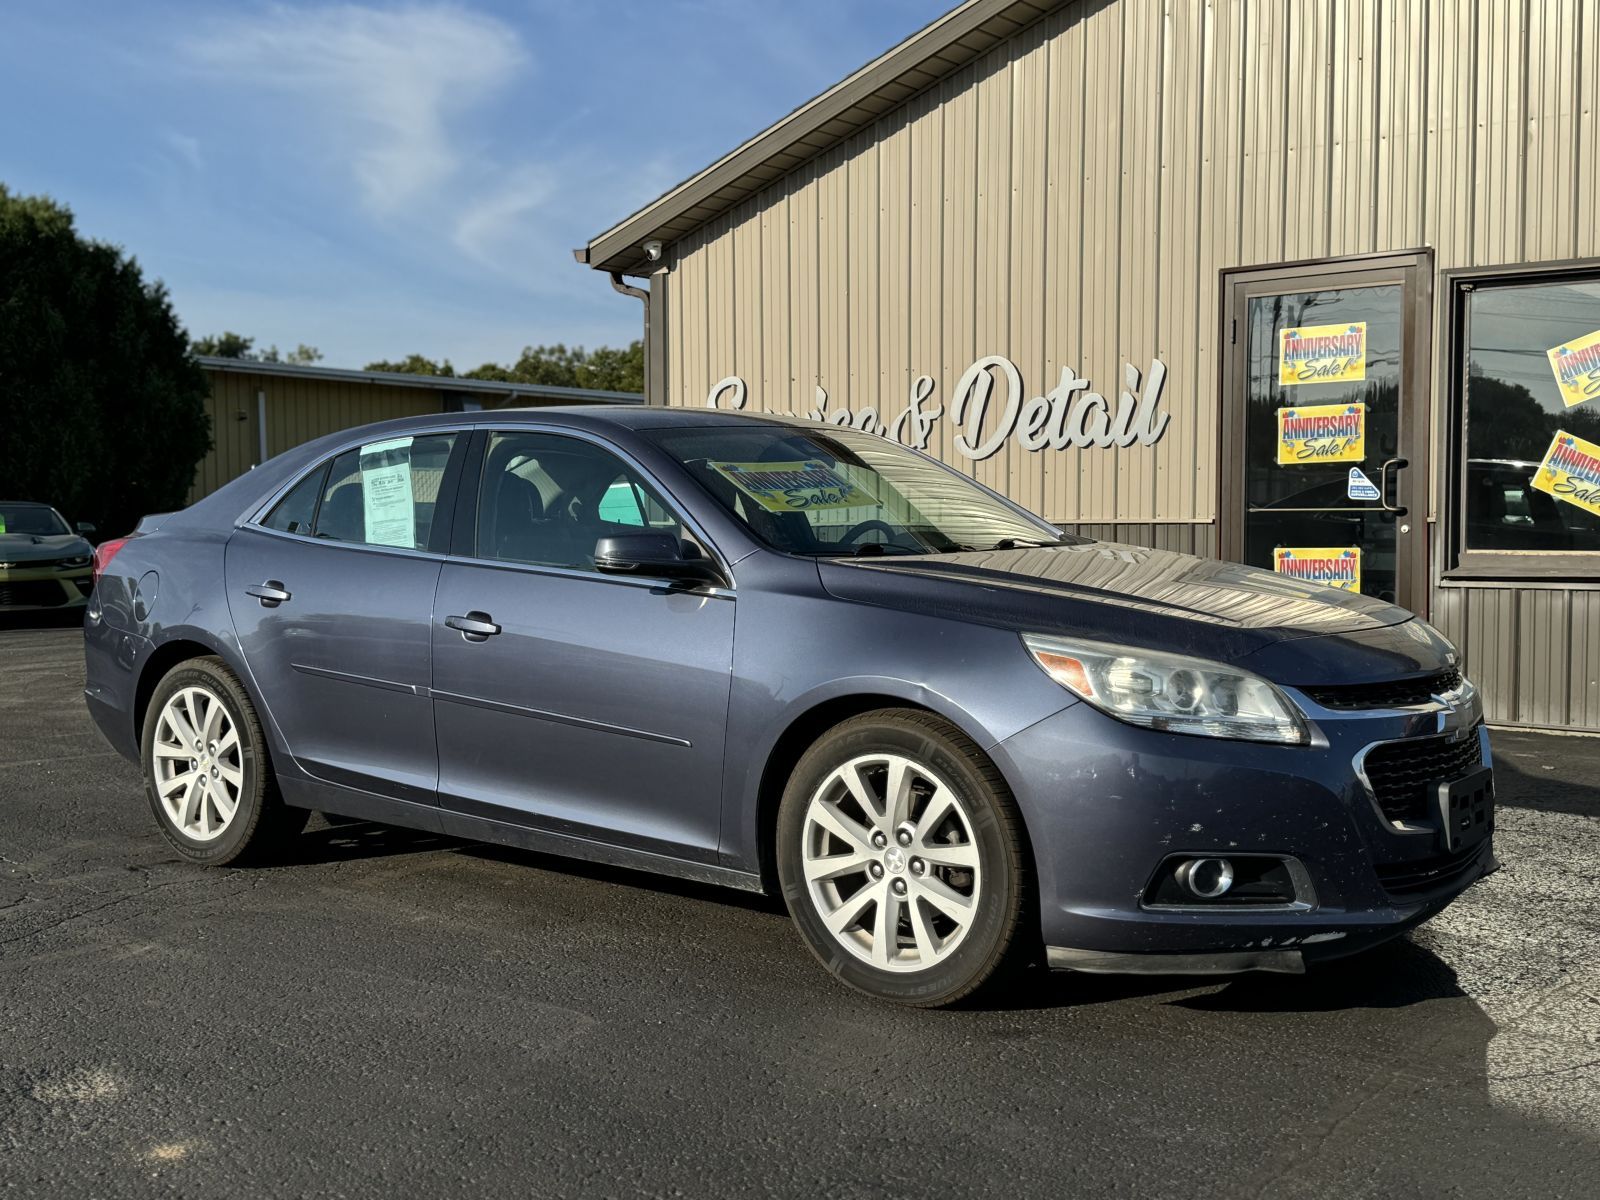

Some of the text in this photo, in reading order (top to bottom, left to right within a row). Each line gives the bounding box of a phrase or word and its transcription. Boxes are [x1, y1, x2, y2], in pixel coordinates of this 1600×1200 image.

[1284, 334, 1362, 361] ANNIVERSARY
[1297, 358, 1351, 380] Sale!
[890, 375, 944, 450] &
[951, 355, 1170, 461] Detail
[1283, 414, 1360, 440] ANNIVERSARY
[1296, 437, 1350, 459] Sale!
[729, 468, 848, 491] ANNIVERSARY
[783, 487, 848, 508] Sale!
[1279, 558, 1356, 580] ANNIVERSARY
